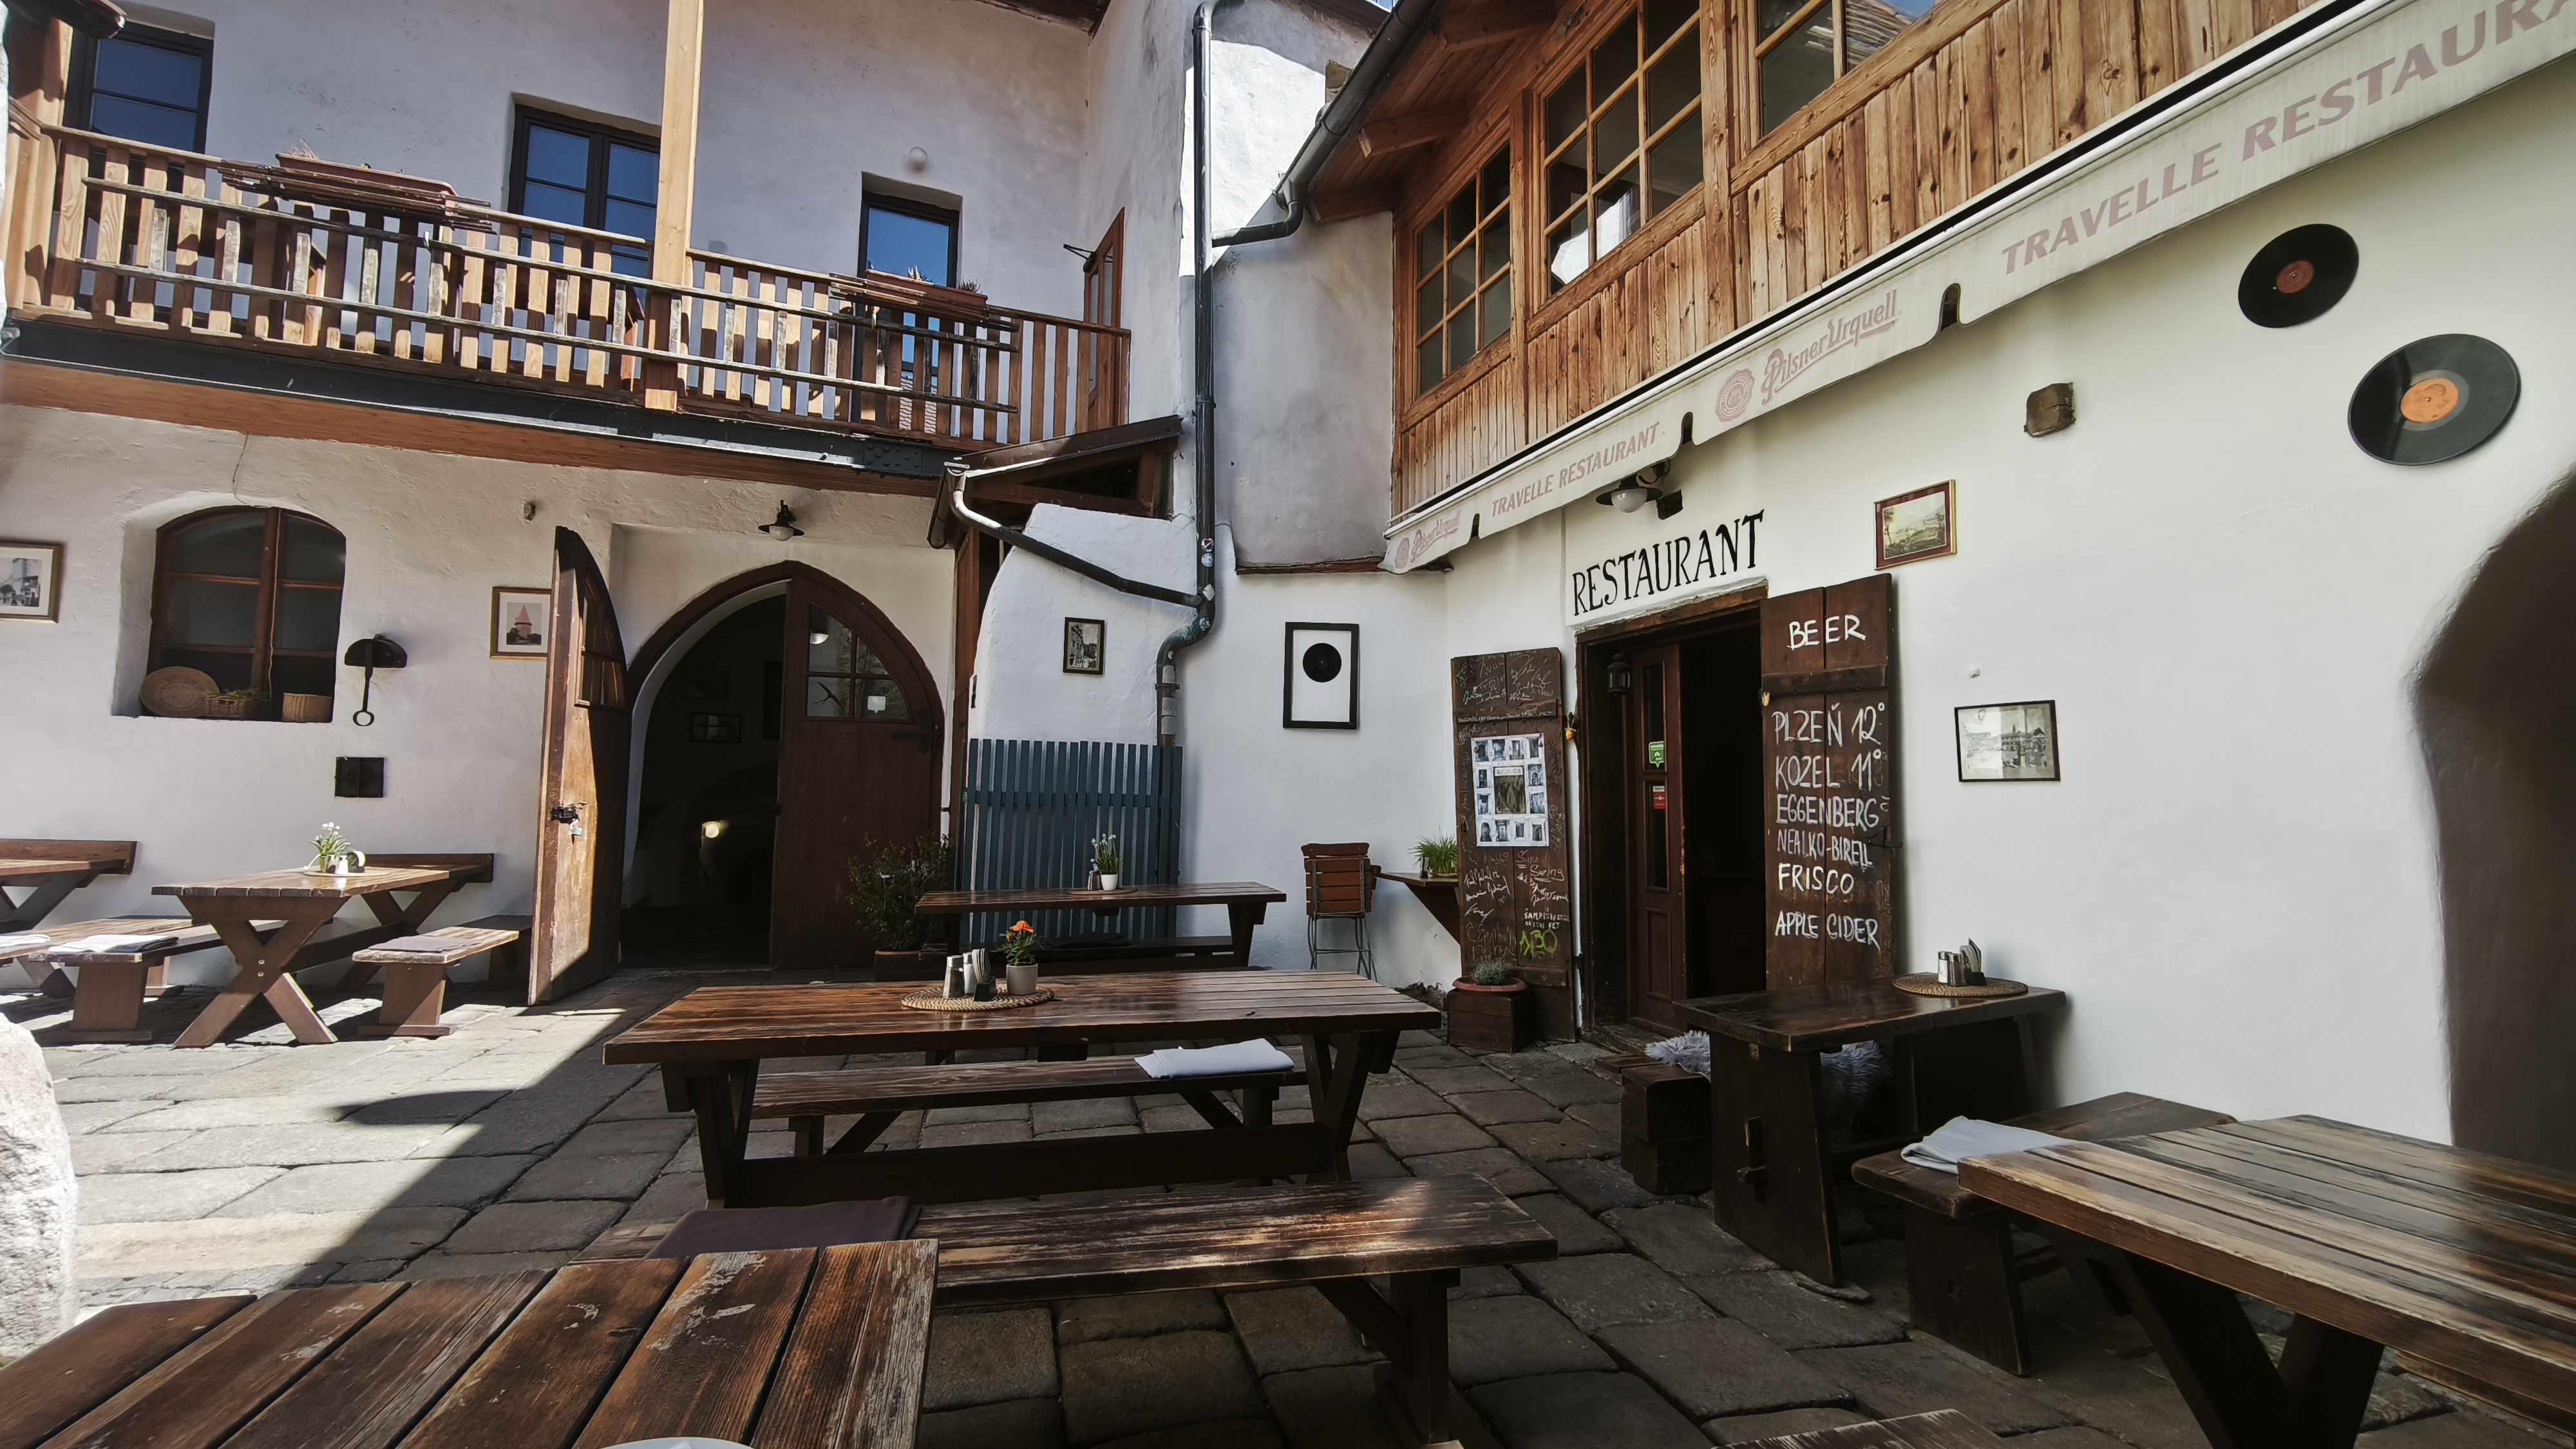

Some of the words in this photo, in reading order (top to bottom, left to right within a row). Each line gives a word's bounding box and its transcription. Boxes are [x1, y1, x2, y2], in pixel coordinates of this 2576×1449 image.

[2001, 142, 2222, 276] TRAVELLE
[1760, 334, 1830, 406] Pilsner
[1826, 289, 1900, 348] Urquell
[1491, 474, 1554, 517] TRAVELLE
[1558, 421, 1660, 489] RESTAURANT
[1572, 509, 1765, 616] RESTAURANT
[1786, 614, 1867, 650] BEER
[1776, 755, 1841, 791] KOZEL
[1776, 793, 1880, 832] EGGENBERG
[1778, 862, 1855, 895] FRISCO
[1775, 909, 1819, 940] APPLE
[1826, 913, 1882, 952] CIDER
